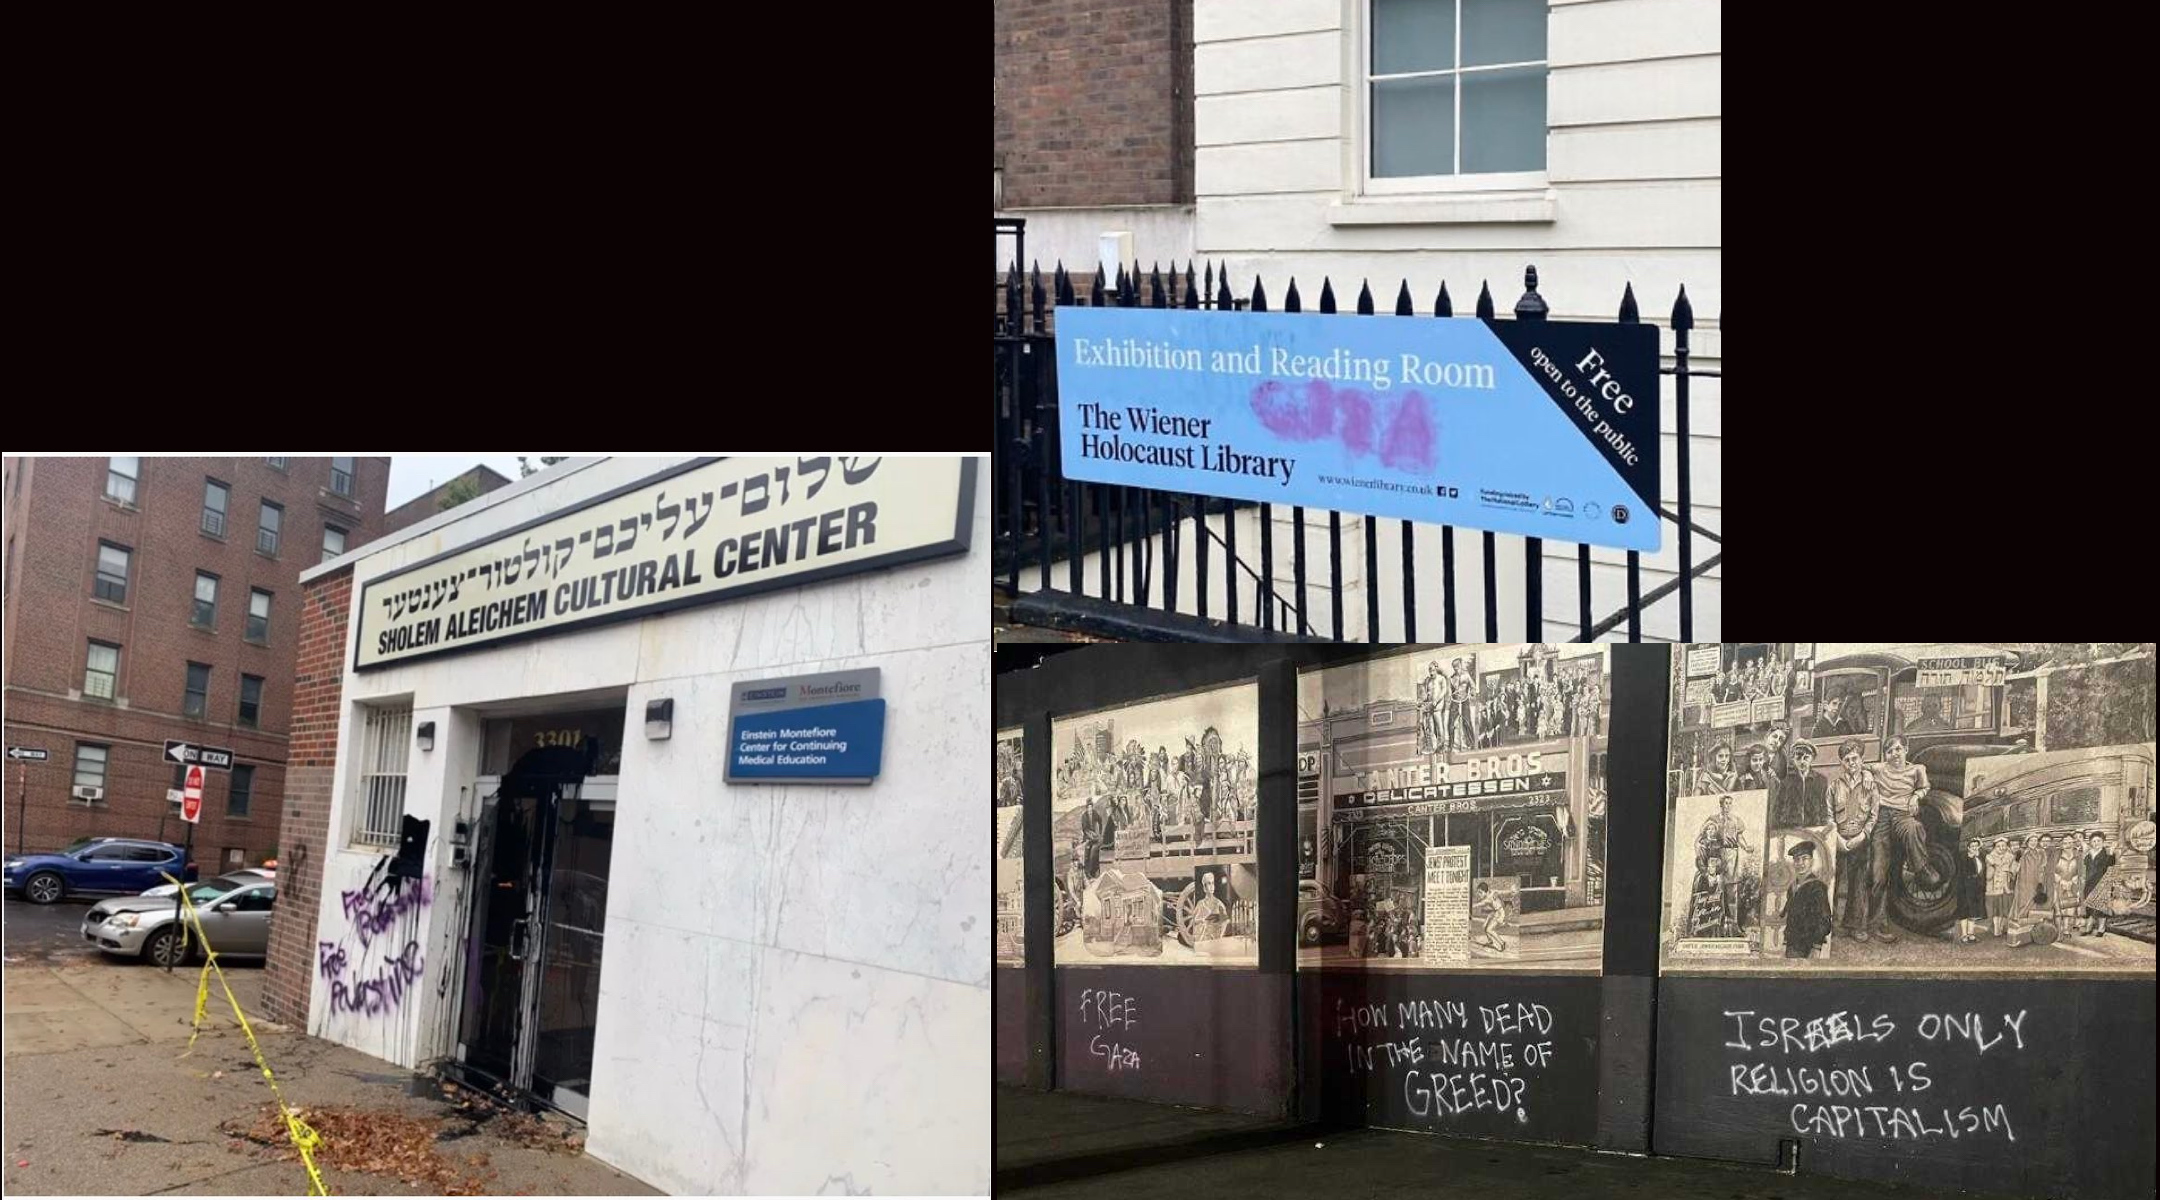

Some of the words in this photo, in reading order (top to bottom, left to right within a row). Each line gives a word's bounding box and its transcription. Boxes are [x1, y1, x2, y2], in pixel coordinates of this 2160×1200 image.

[1073, 337, 1203, 371] Exhibition
[1211, 345, 1262, 374] and
[1271, 346, 1390, 391] Reading
[1399, 354, 1496, 389] Room
[1575, 346, 1634, 415] Free
[1078, 402, 1122, 431] The
[1127, 407, 1212, 440] Wiener
[1530, 346, 1563, 383] open
[1560, 380, 1577, 399] to
[1574, 395, 1600, 422] the
[1592, 420, 1639, 467] public
[1081, 433, 1196, 470] Holocaust
[1200, 443, 1296, 487] Library
[378, 617, 441, 656] SHOLEM
[445, 588, 549, 643] ALEICHEM
[553, 548, 702, 616] CULTURAL
[713, 500, 879, 580] CENTER
[1920, 658, 1968, 671] SCHOOL
[799, 681, 862, 697] Montefiore
[740, 742, 771, 753] Center
[773, 741, 787, 752] for
[790, 740, 848, 754] Continuing
[741, 729, 778, 741] Einstein
[780, 726, 837, 739] Montefiore
[206, 753, 227, 763] WAY
[738, 755, 775, 766] Medical
[777, 754, 827, 765] Education
[1467, 751, 1542, 782] BROS
[1362, 776, 1530, 804] DELICATESSEN
[1407, 802, 1447, 814] CANTER
[1080, 988, 1137, 1031] FREE
[1338, 1000, 1388, 1037] HOW
[1399, 1000, 1468, 1030] MANY
[1479, 1002, 1553, 1035] DEAD
[1917, 1009, 2027, 1055] ONLY
[1090, 1034, 1141, 1070] GAZA
[1348, 1043, 1374, 1074] IN
[1376, 1036, 1425, 1069] THE
[1440, 1038, 1515, 1070] NAME
[1523, 1040, 1552, 1069] OF
[1404, 1070, 1529, 1124] GREED?
[1730, 1062, 1874, 1098] RELIGION
[1889, 1061, 1932, 1093] IS
[1790, 1102, 2016, 1142] CAPITALISM
